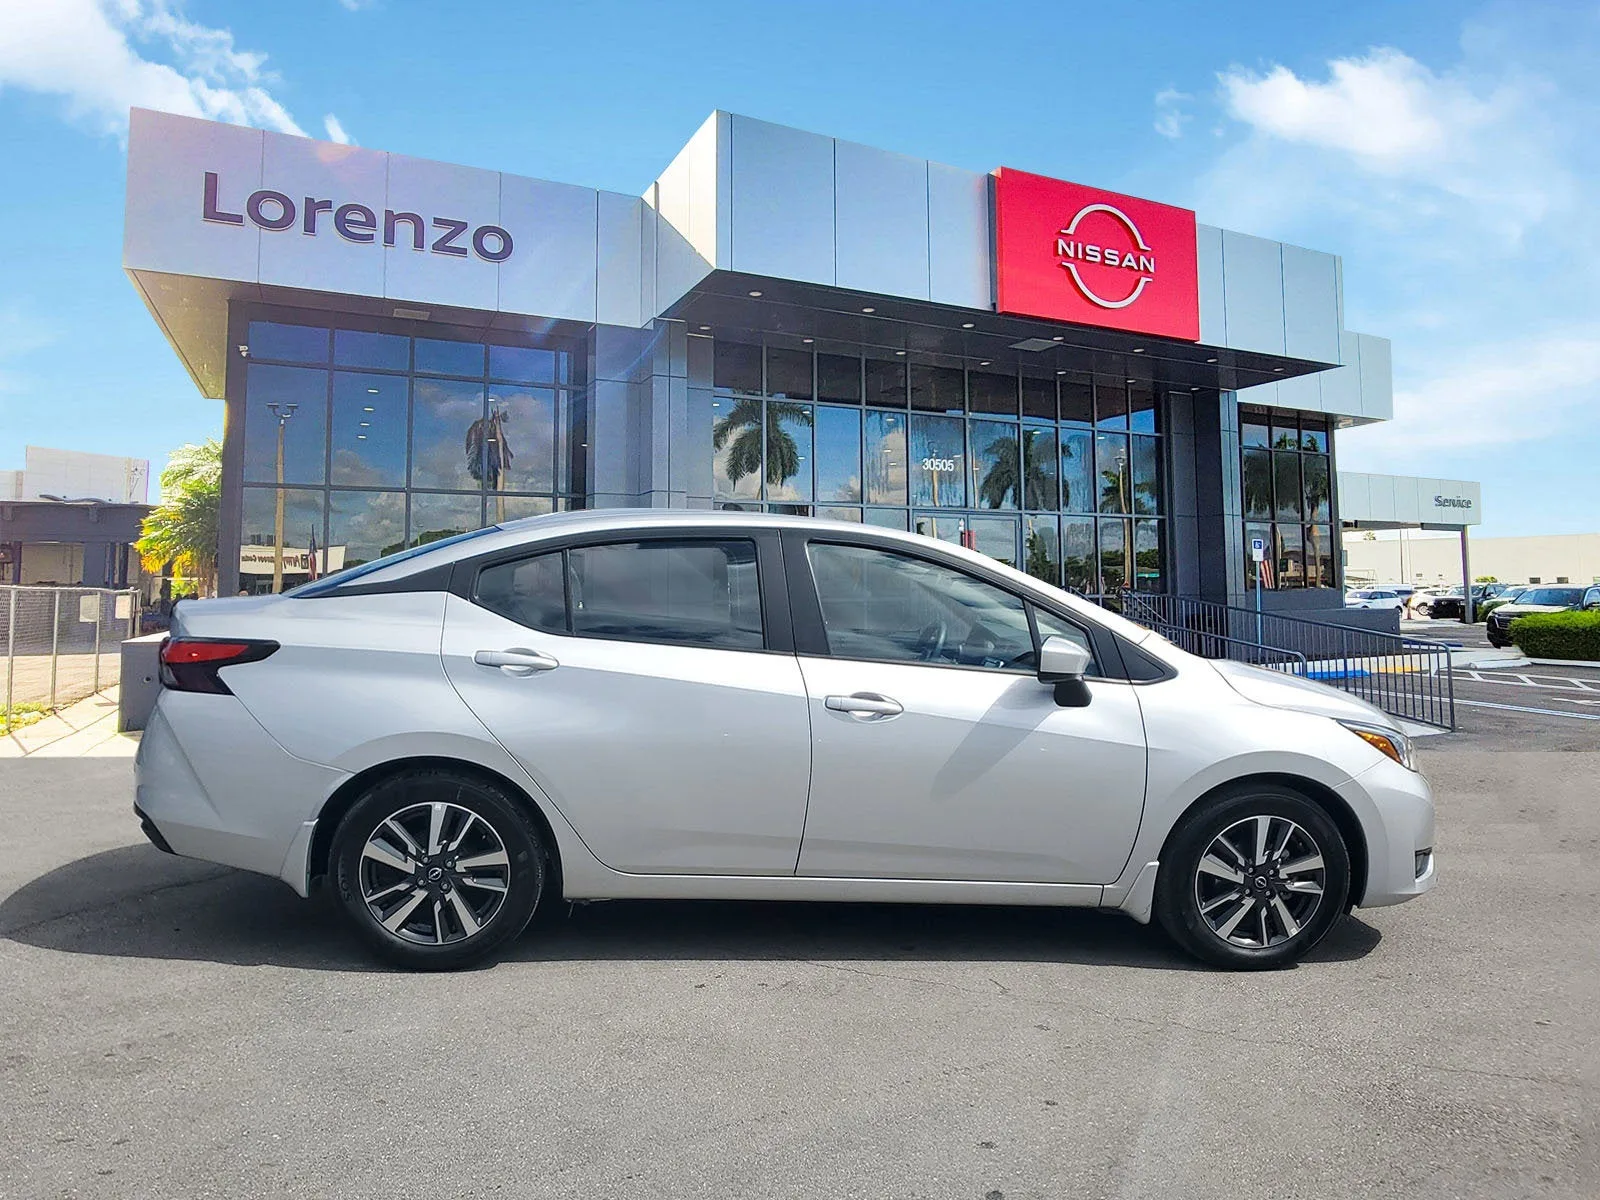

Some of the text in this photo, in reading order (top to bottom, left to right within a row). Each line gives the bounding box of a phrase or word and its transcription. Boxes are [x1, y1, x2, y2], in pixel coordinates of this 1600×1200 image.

[203, 171, 514, 262] Lorenzo
[1057, 238, 1155, 273] NISSAN
[922, 458, 954, 472] 30505
[1434, 495, 1472, 508] Service
